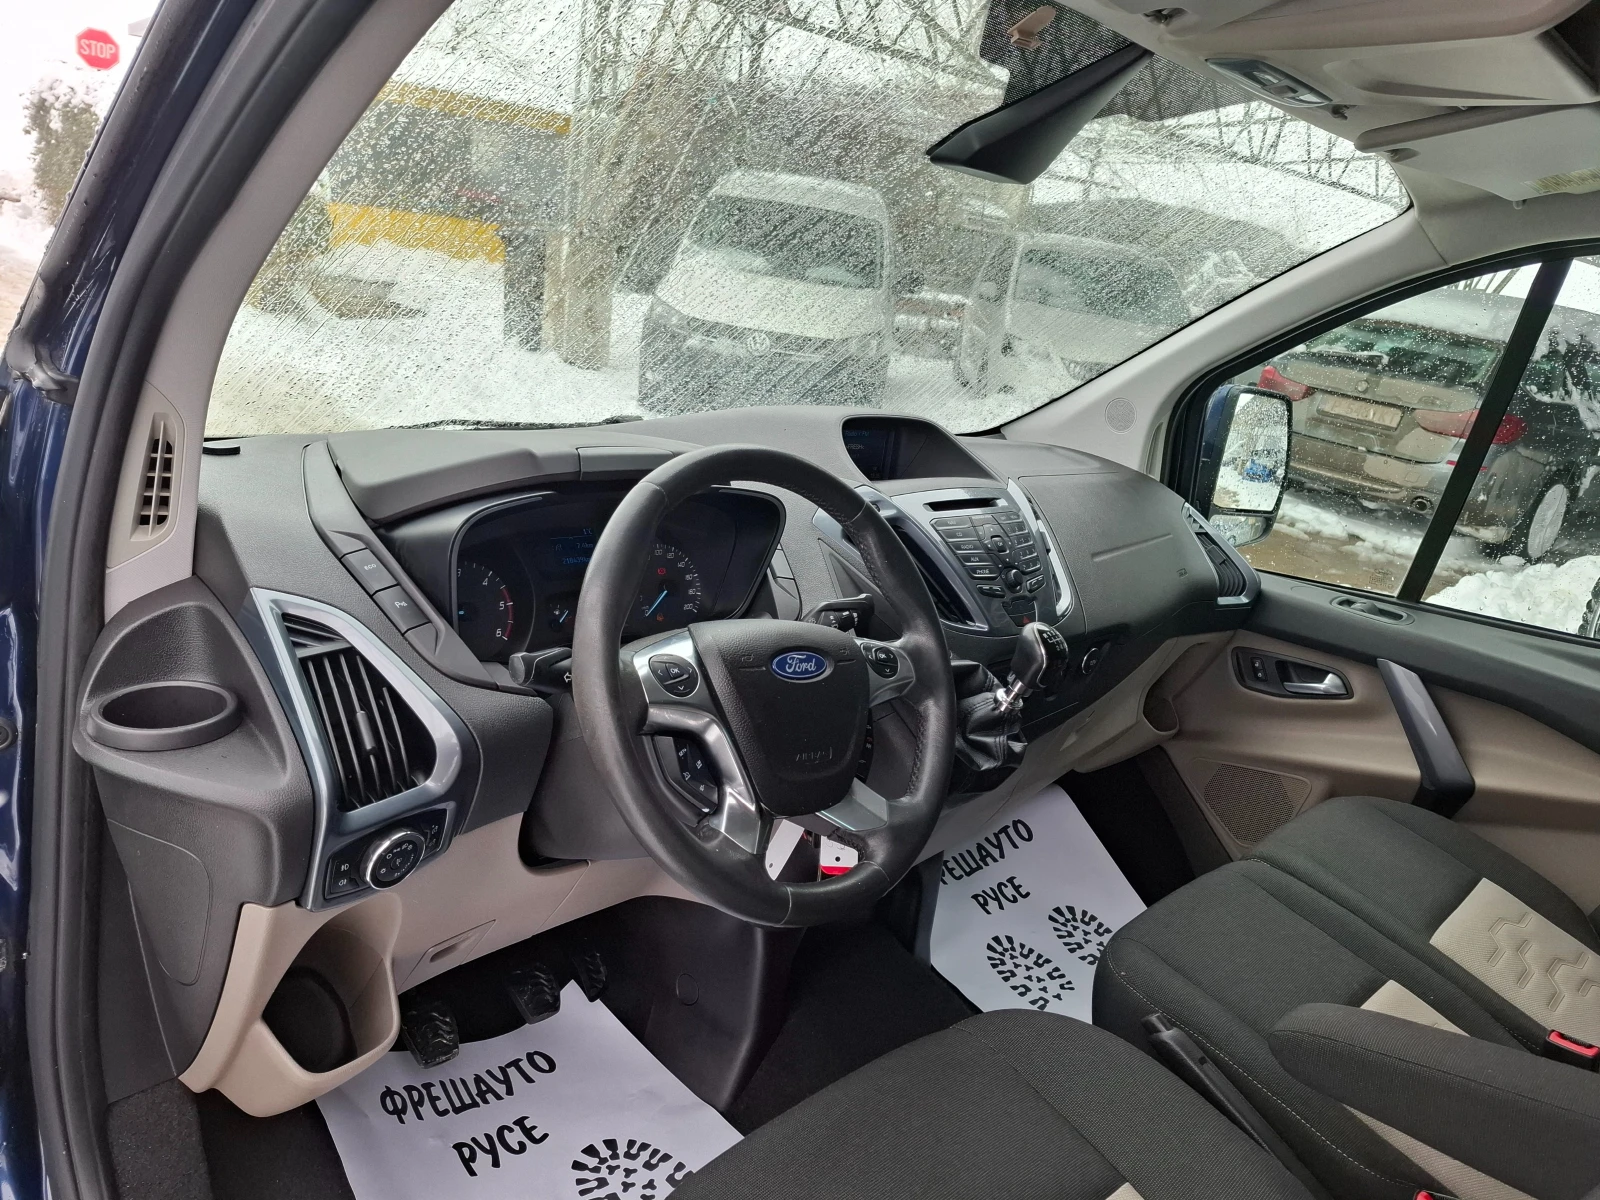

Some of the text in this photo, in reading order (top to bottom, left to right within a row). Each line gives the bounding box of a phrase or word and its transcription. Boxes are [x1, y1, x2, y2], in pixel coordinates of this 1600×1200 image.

[80, 38, 116, 59] STOP
[363, 563, 377, 571] ECO
[482, 577, 489, 586] 4
[499, 601, 505, 610] 5
[683, 603, 694, 611] 200
[495, 628, 502, 637] 6
[785, 654, 817, 673] Ford
[970, 875, 1031, 915] РУСЕ
[379, 1050, 557, 1125] ФРЕШАУТО
[451, 1114, 550, 1177] РУСЕ
